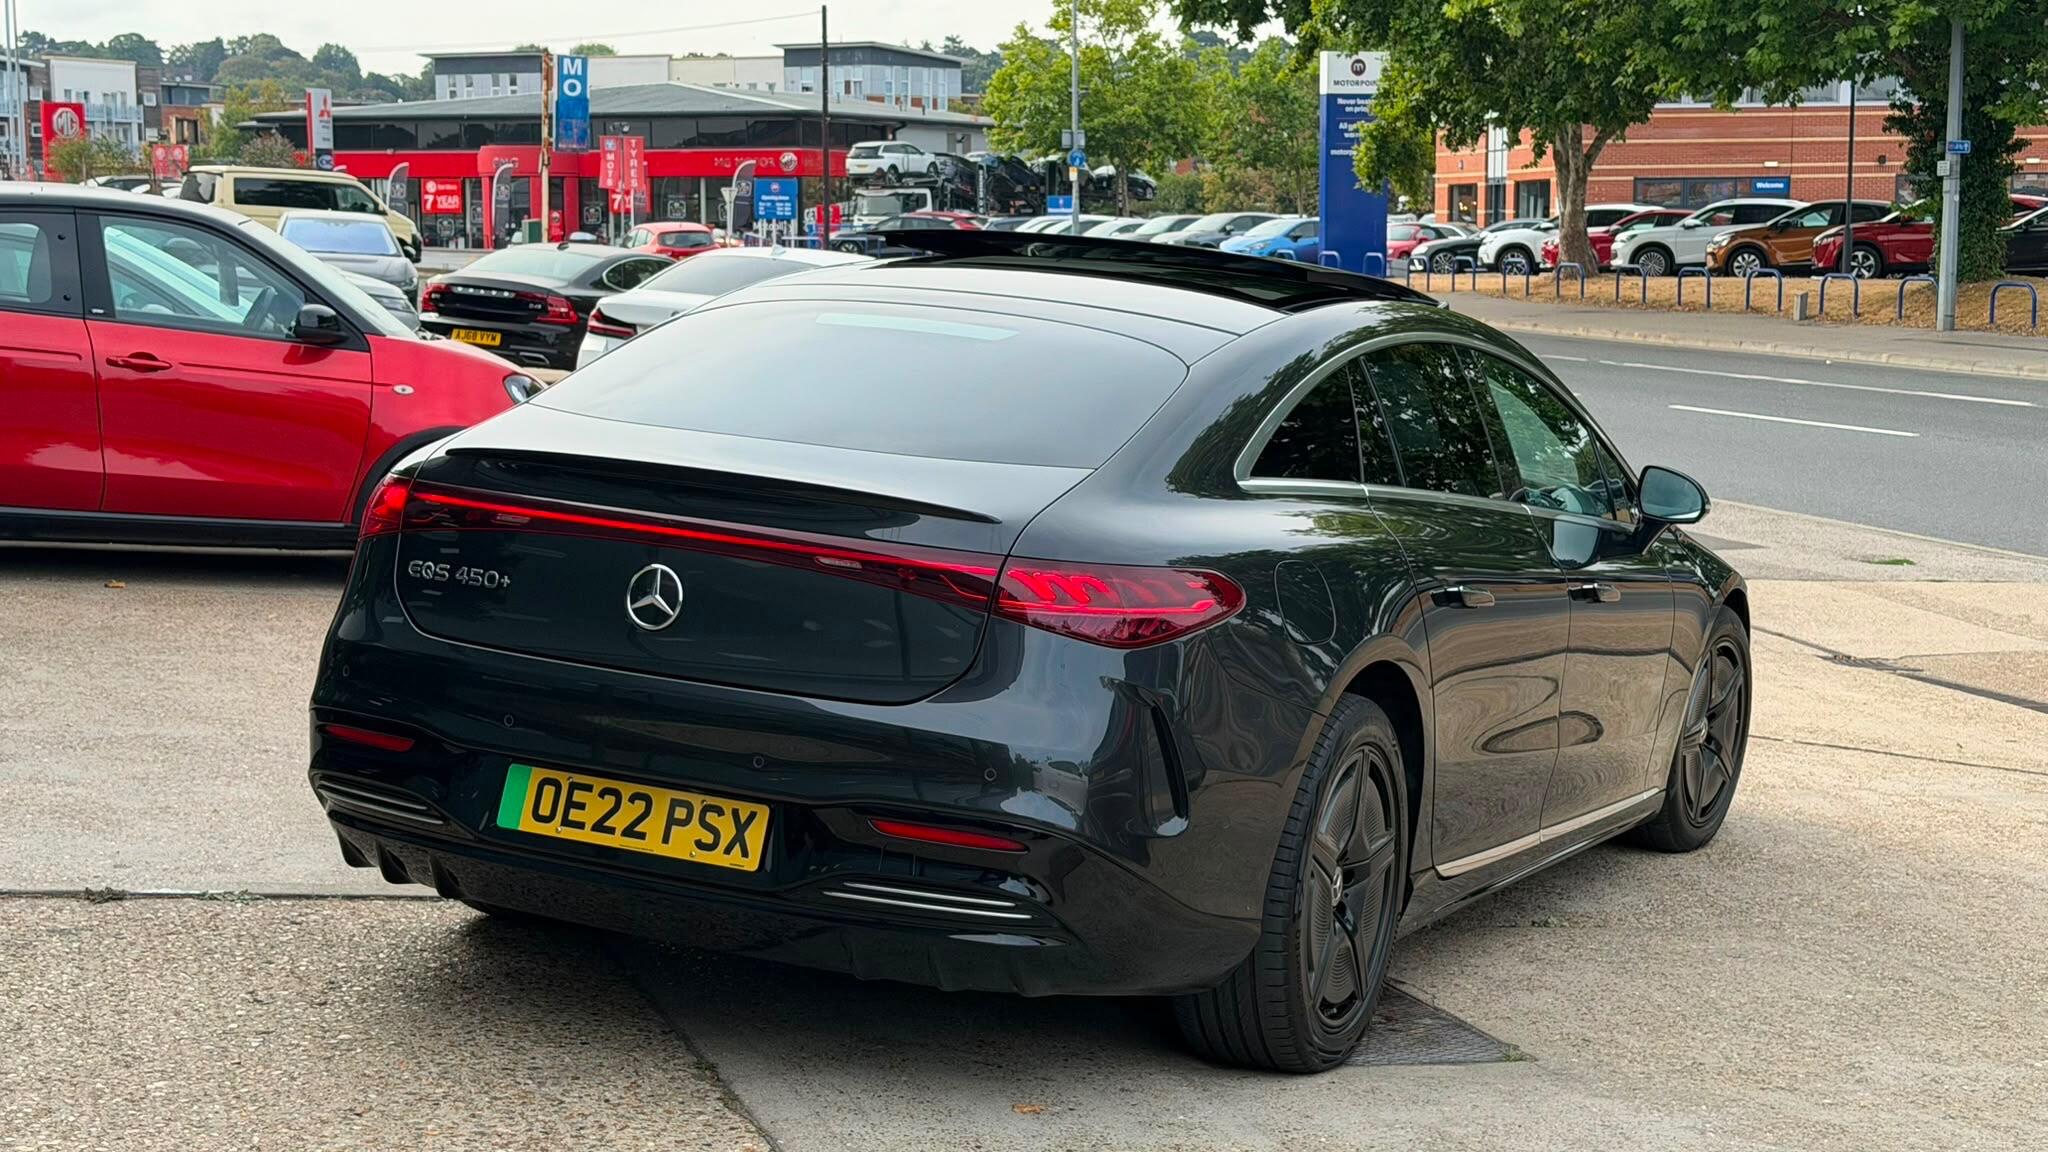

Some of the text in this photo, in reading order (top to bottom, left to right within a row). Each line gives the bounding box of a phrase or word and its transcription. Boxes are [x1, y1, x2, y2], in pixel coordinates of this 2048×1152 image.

[1333, 79, 1377, 87] MOTORPOIN
[55, 110, 78, 136] MG
[606, 152, 615, 187] MOTS
[630, 139, 638, 188] TYRES
[424, 194, 434, 210] 7
[612, 194, 622, 210] 7
[408, 560, 511, 589] EQS 450+
[532, 776, 758, 859] OE22 PSX
